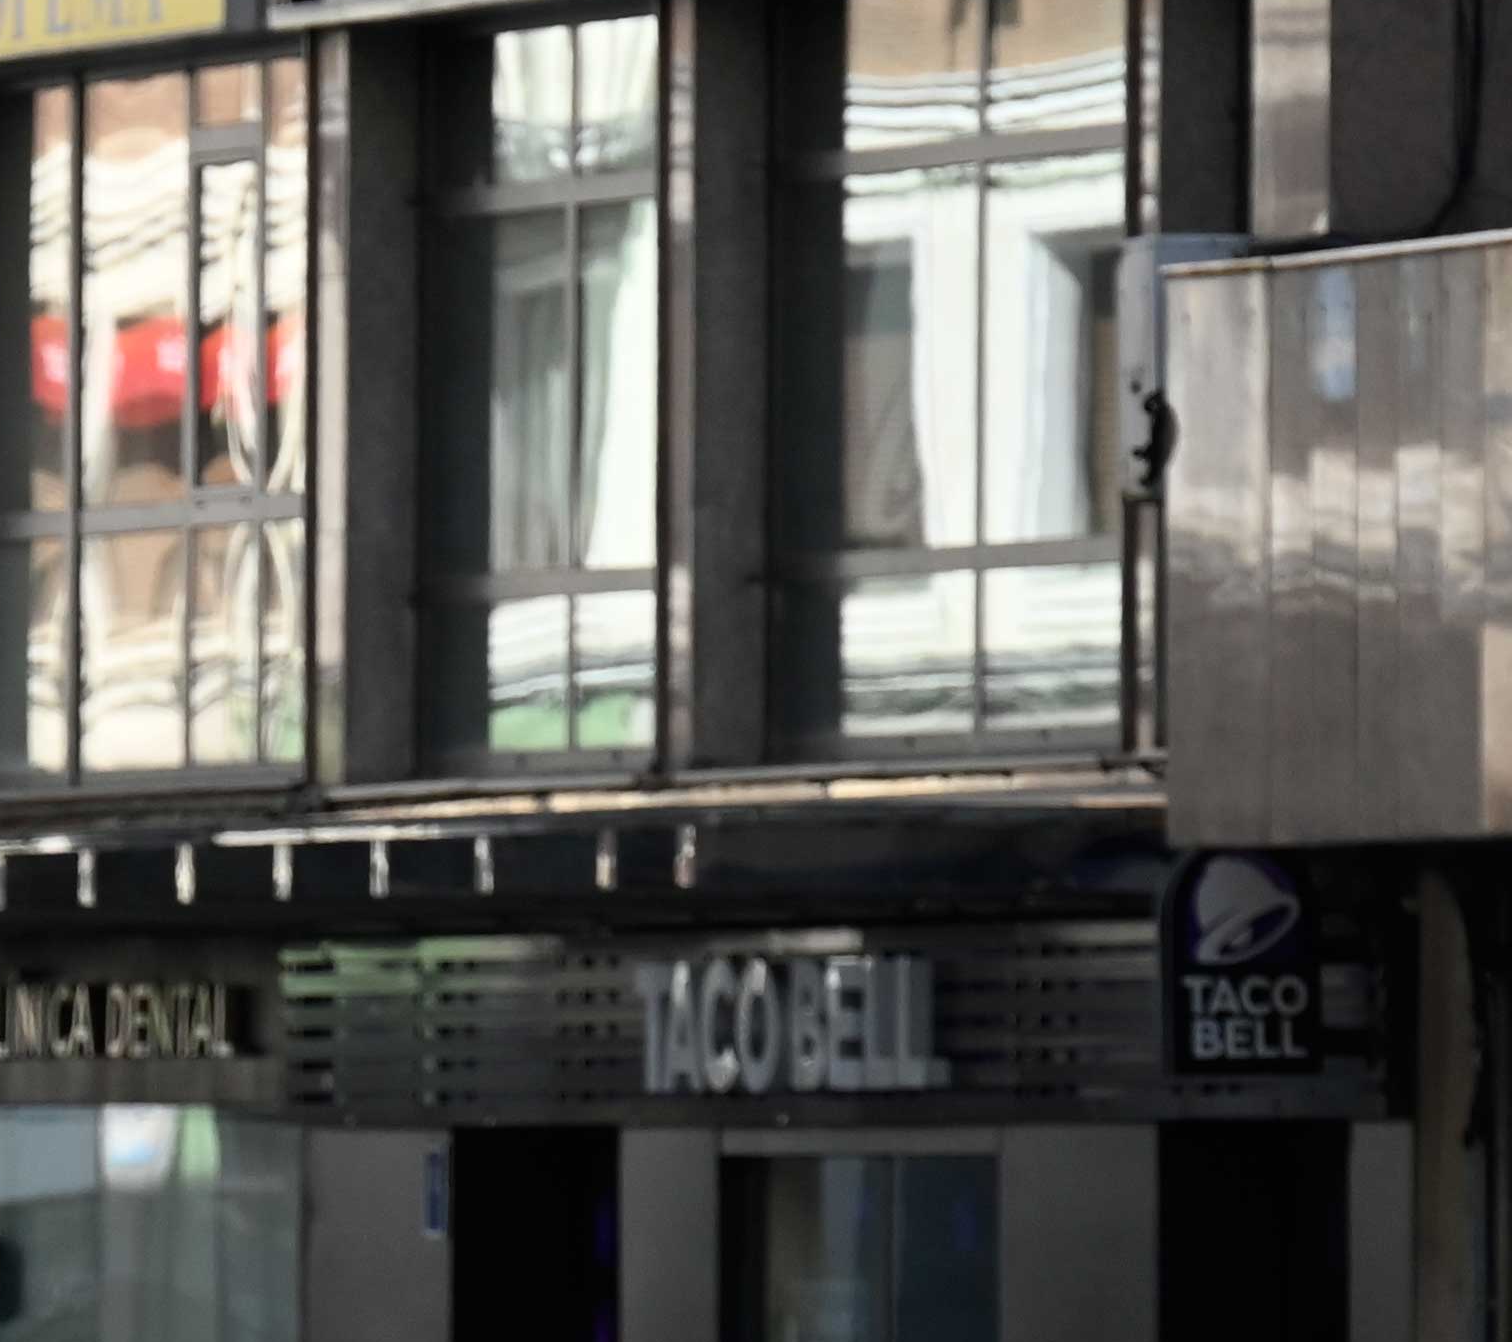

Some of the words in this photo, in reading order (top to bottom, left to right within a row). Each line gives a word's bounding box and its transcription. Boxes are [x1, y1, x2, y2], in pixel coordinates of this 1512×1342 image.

[1183, 973, 1309, 1017] TACO
[636, 958, 778, 1094] TACO
[790, 955, 952, 1092] BELL
[1192, 1017, 1309, 1060] BELL
